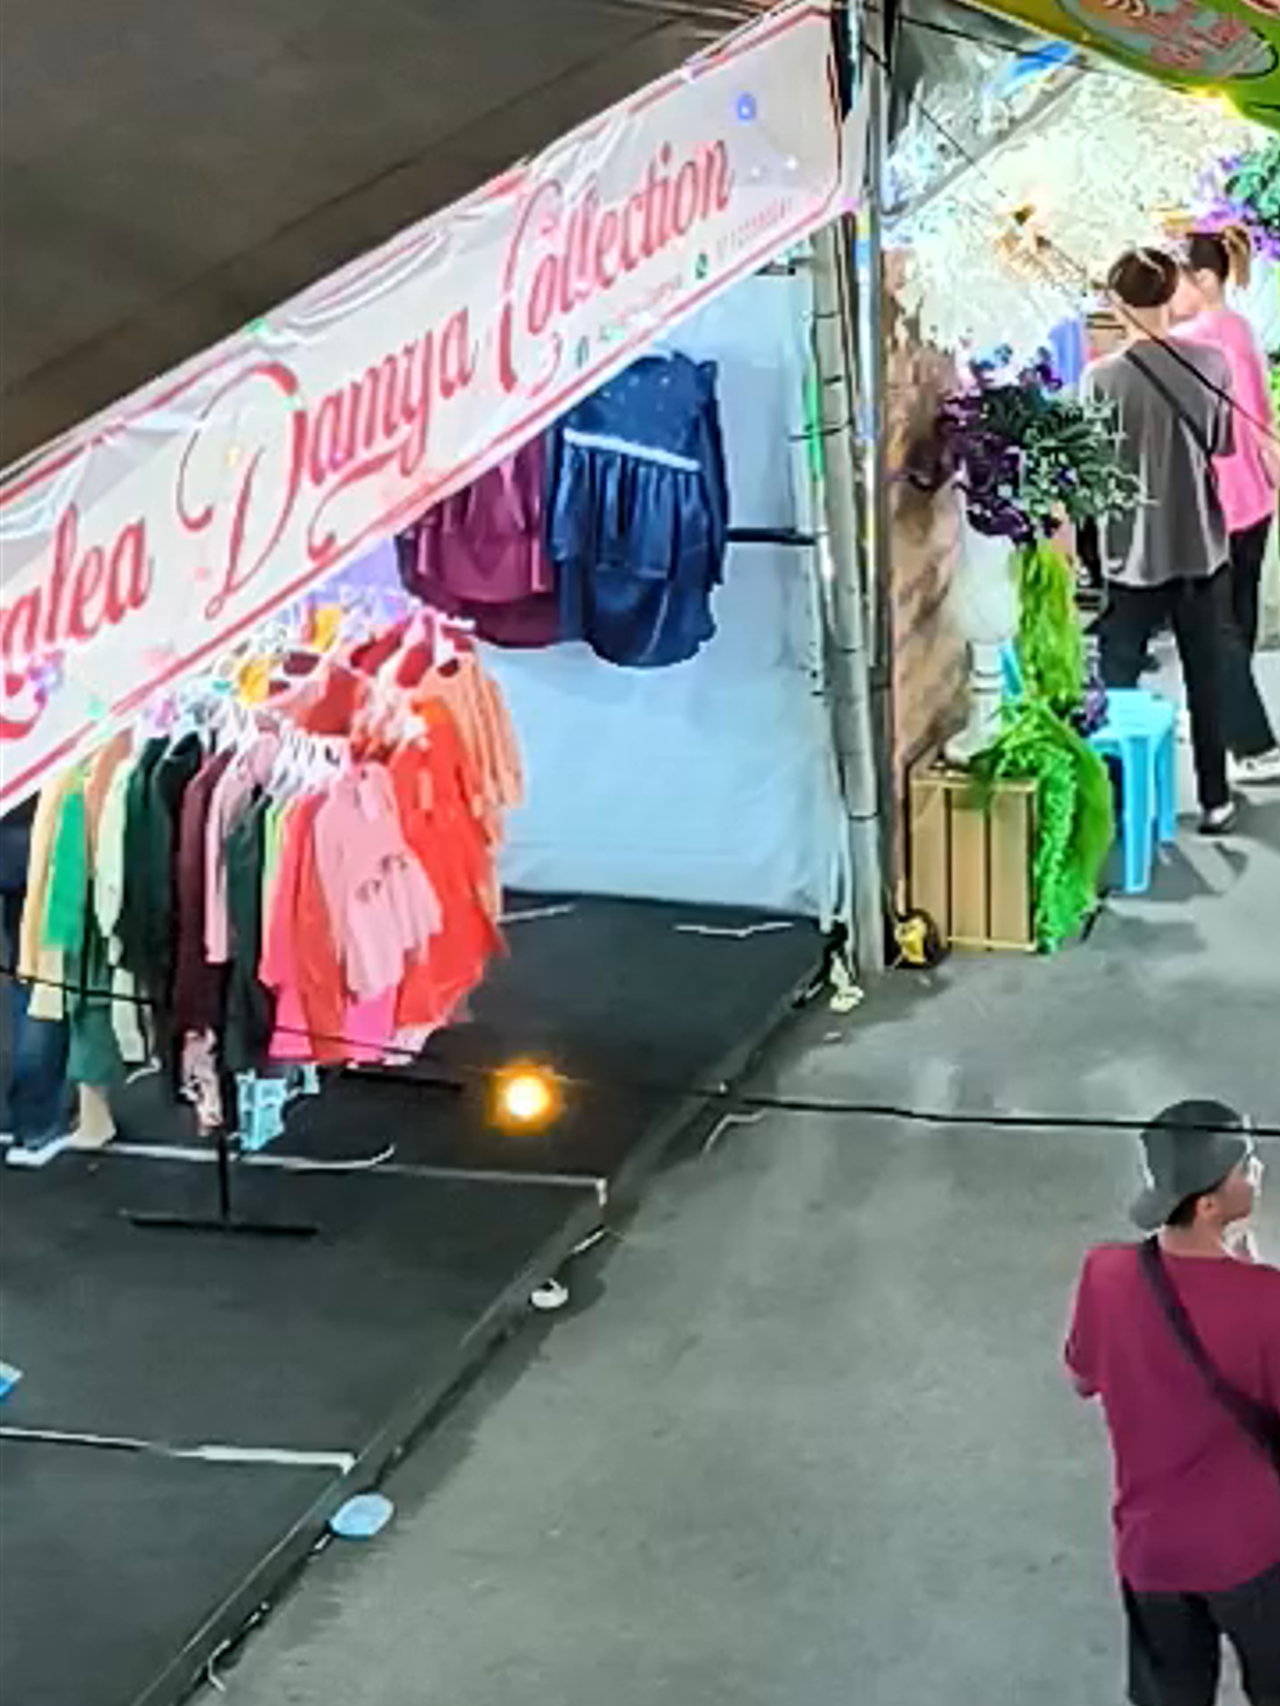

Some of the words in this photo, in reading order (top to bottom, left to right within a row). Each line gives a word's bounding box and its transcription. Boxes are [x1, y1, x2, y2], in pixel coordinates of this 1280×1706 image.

[0, 501, 155, 656] alea
[176, 361, 480, 620] Damya
[499, 139, 735, 402] Collection
